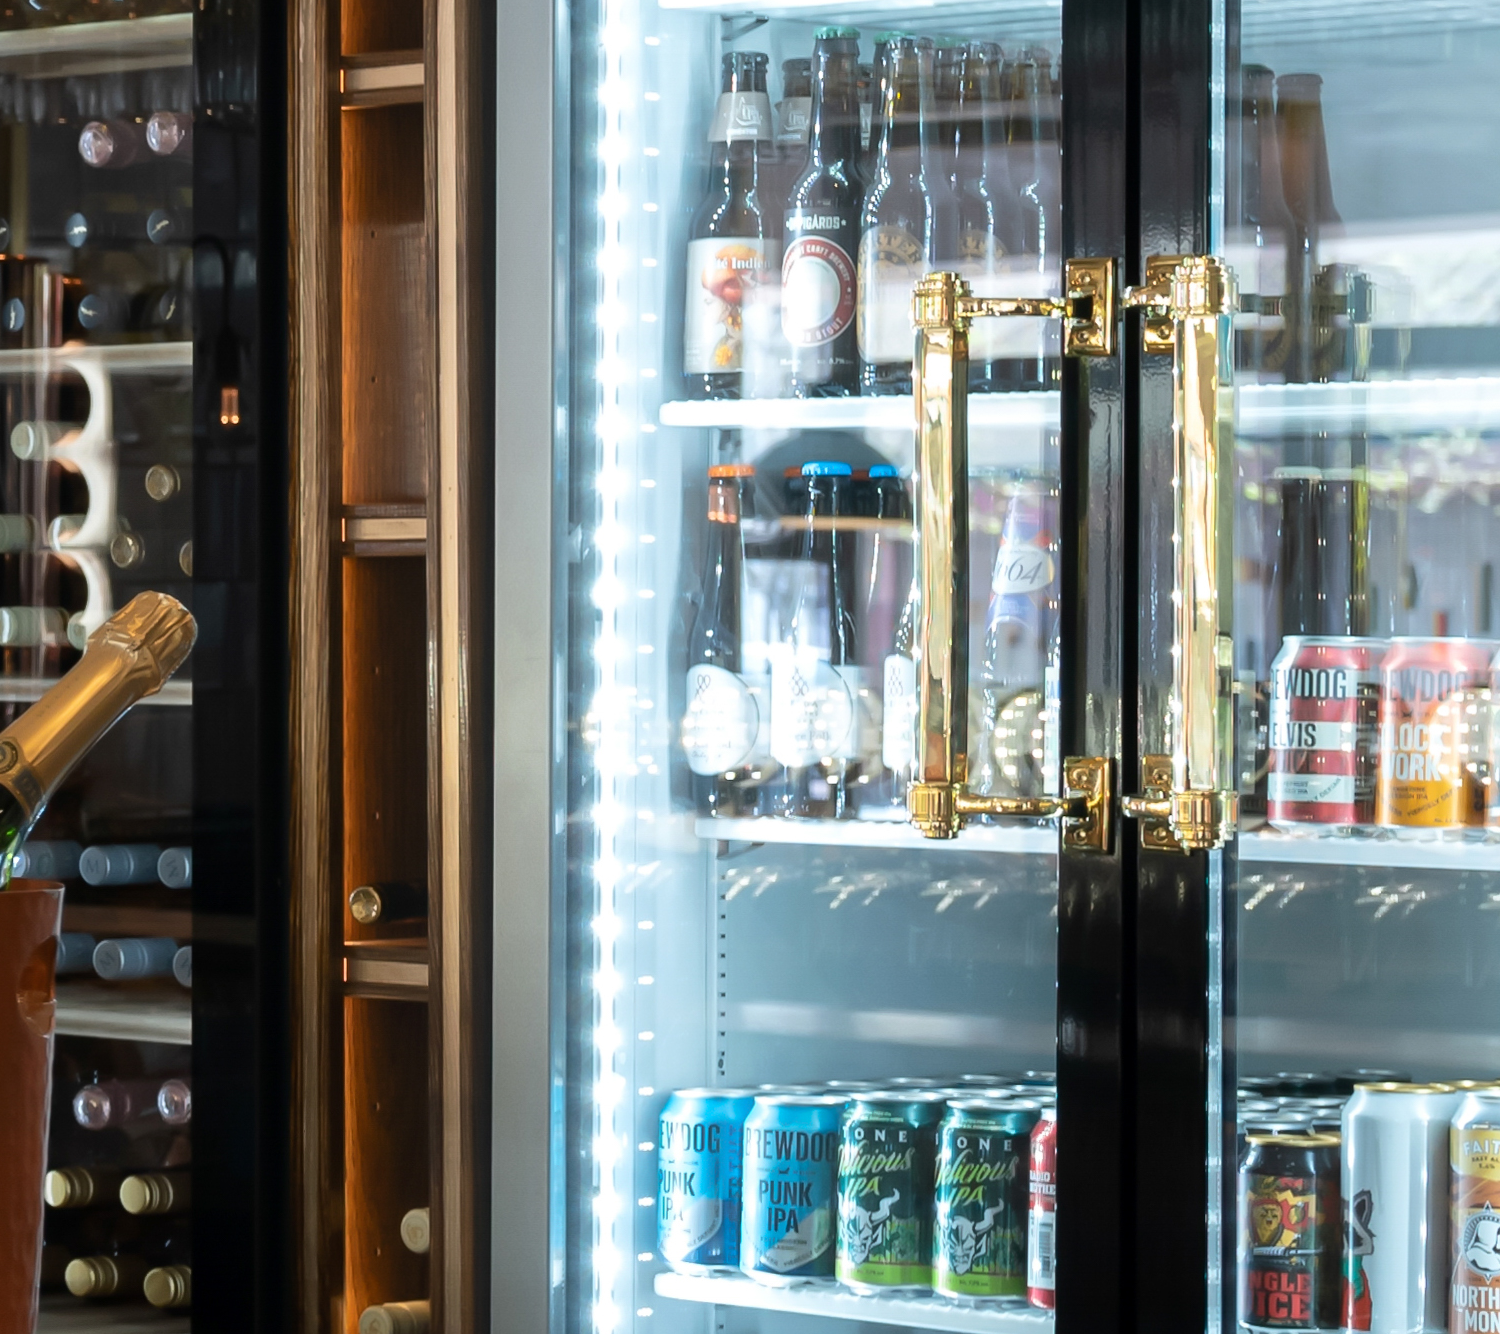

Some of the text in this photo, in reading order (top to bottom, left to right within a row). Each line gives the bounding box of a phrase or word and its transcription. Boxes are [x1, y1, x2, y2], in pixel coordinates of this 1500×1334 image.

[1272, 722, 1317, 748] ELVIS
[759, 1179, 814, 1207] PUNK
[767, 1207, 800, 1234] IPA
